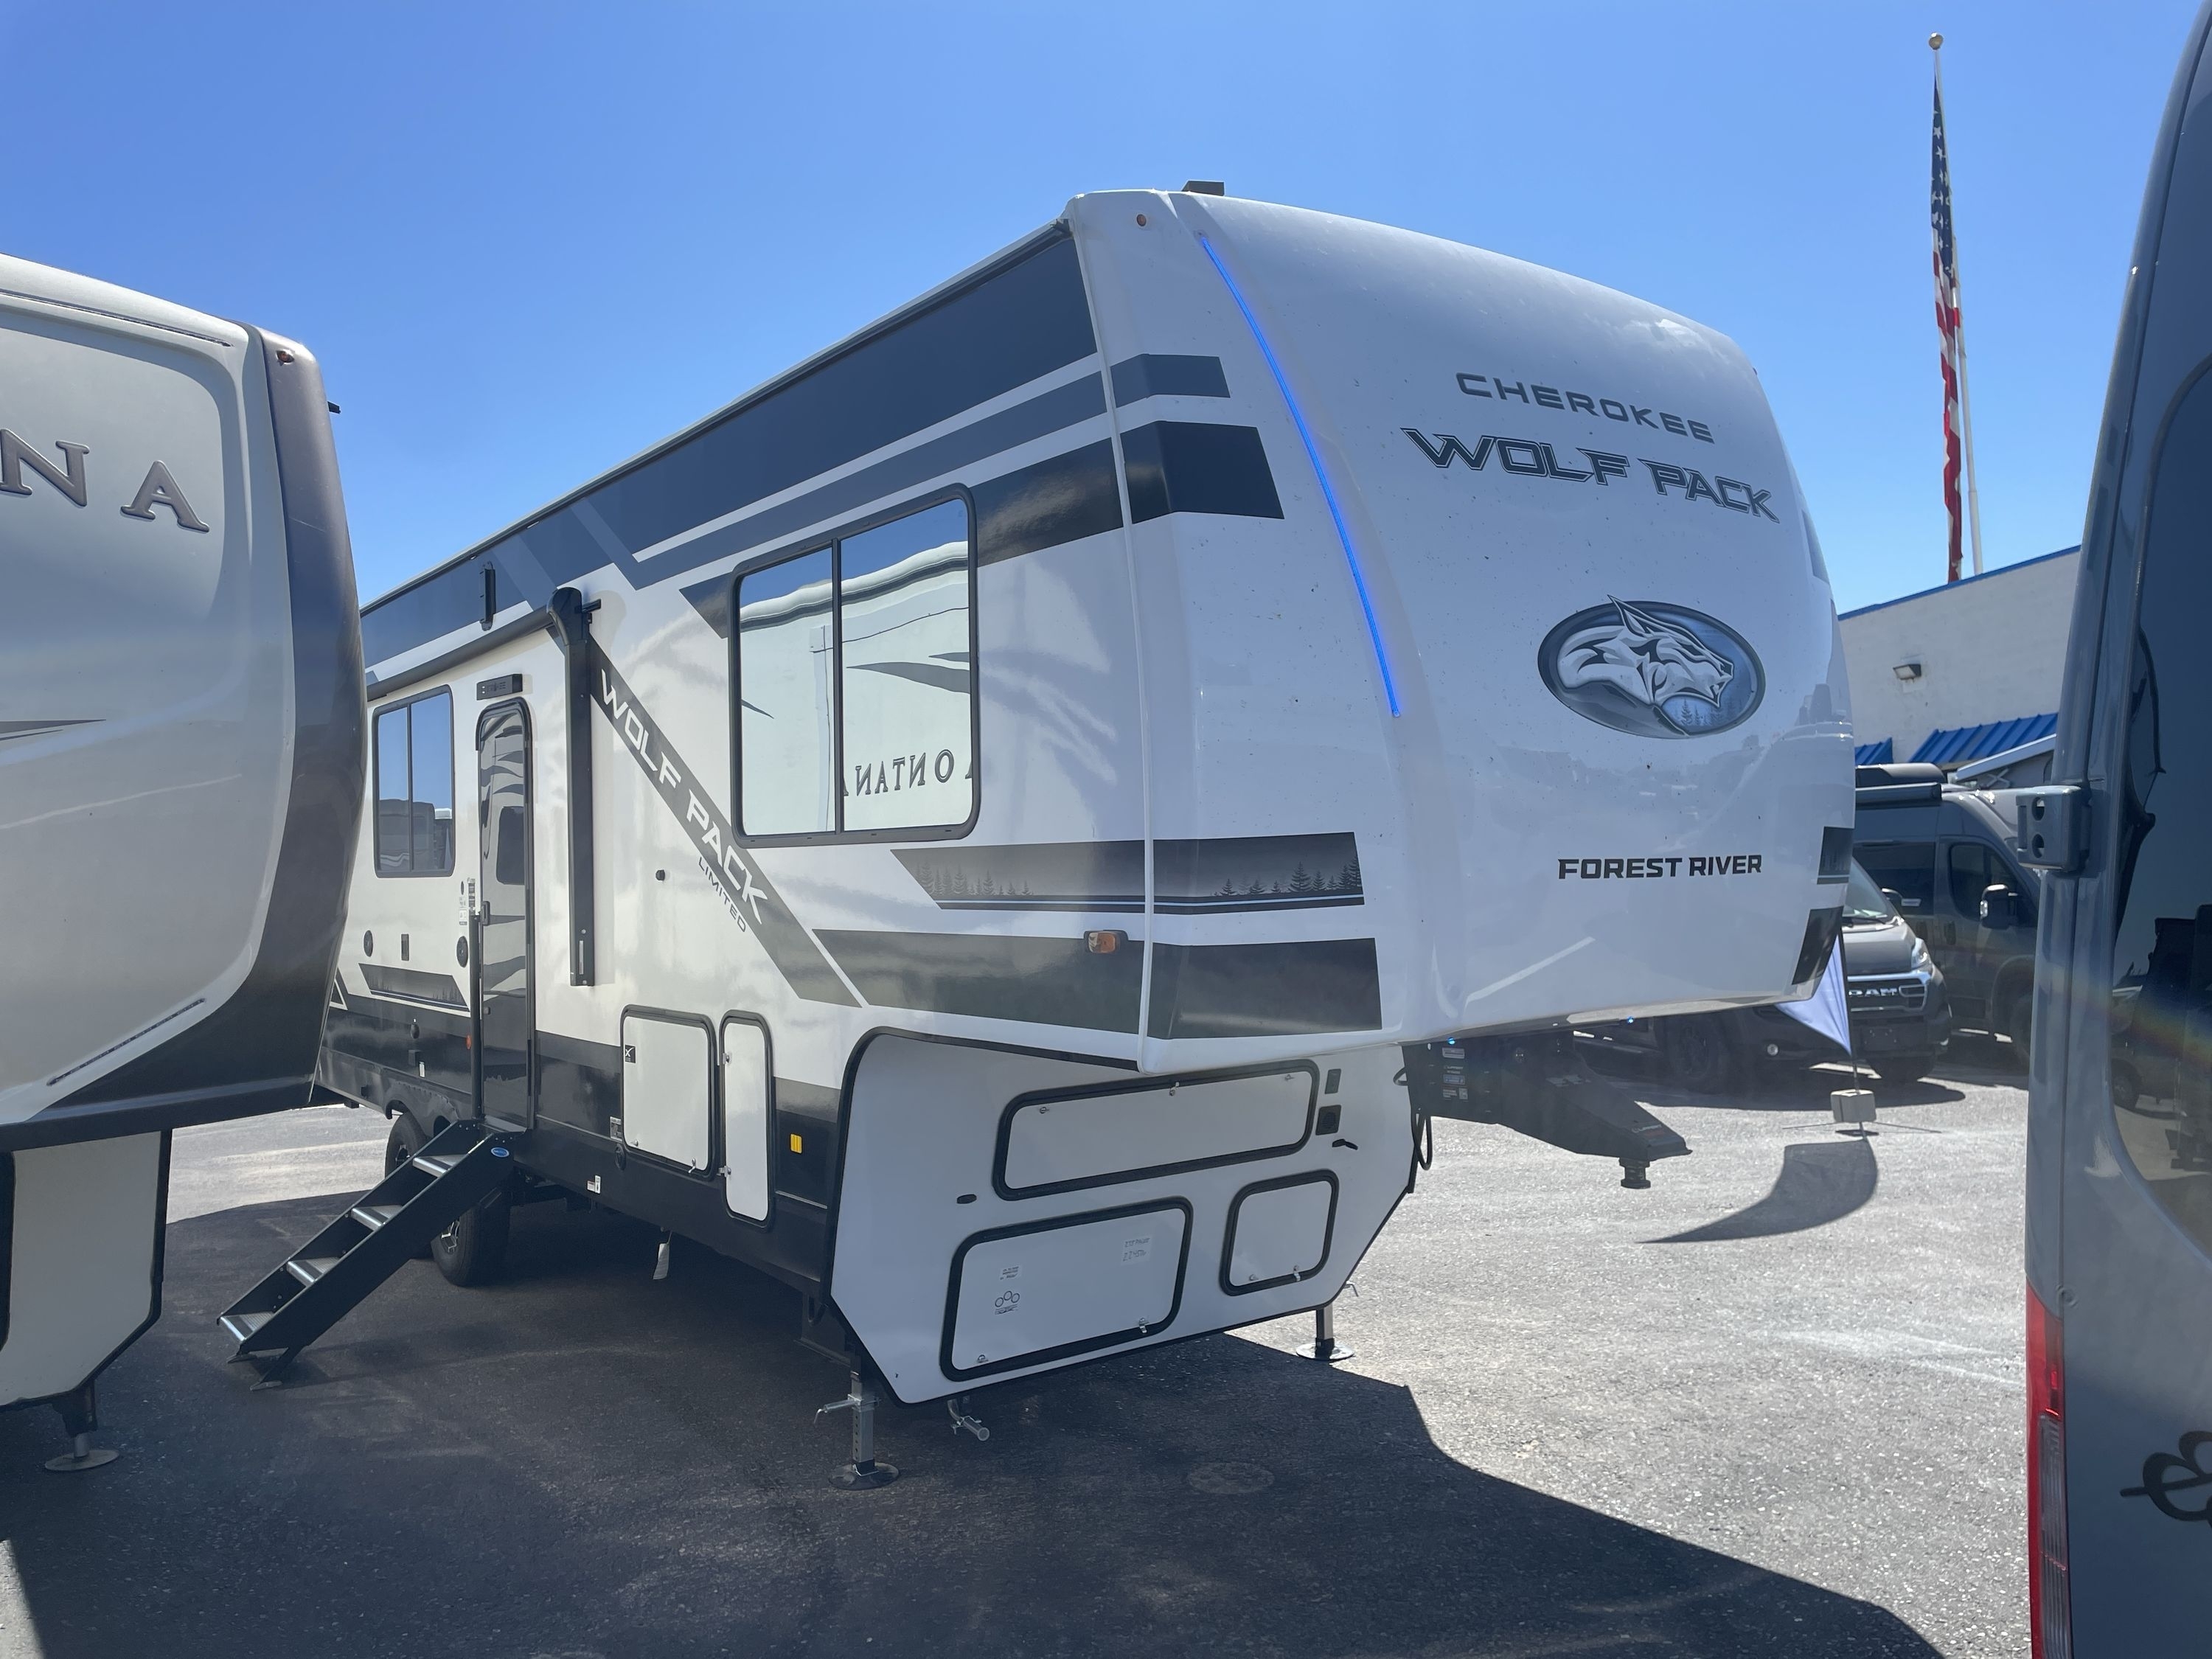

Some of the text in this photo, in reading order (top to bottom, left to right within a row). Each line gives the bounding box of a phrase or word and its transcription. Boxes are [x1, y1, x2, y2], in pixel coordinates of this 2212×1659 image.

[1455, 372, 1714, 445] CHEROKEE
[1402, 427, 1780, 523] WOLF PACK
[601, 668, 768, 925] WOLF PACK
[698, 856, 747, 933] LIMITED
[1558, 855, 1762, 880] FOREST RIVER
